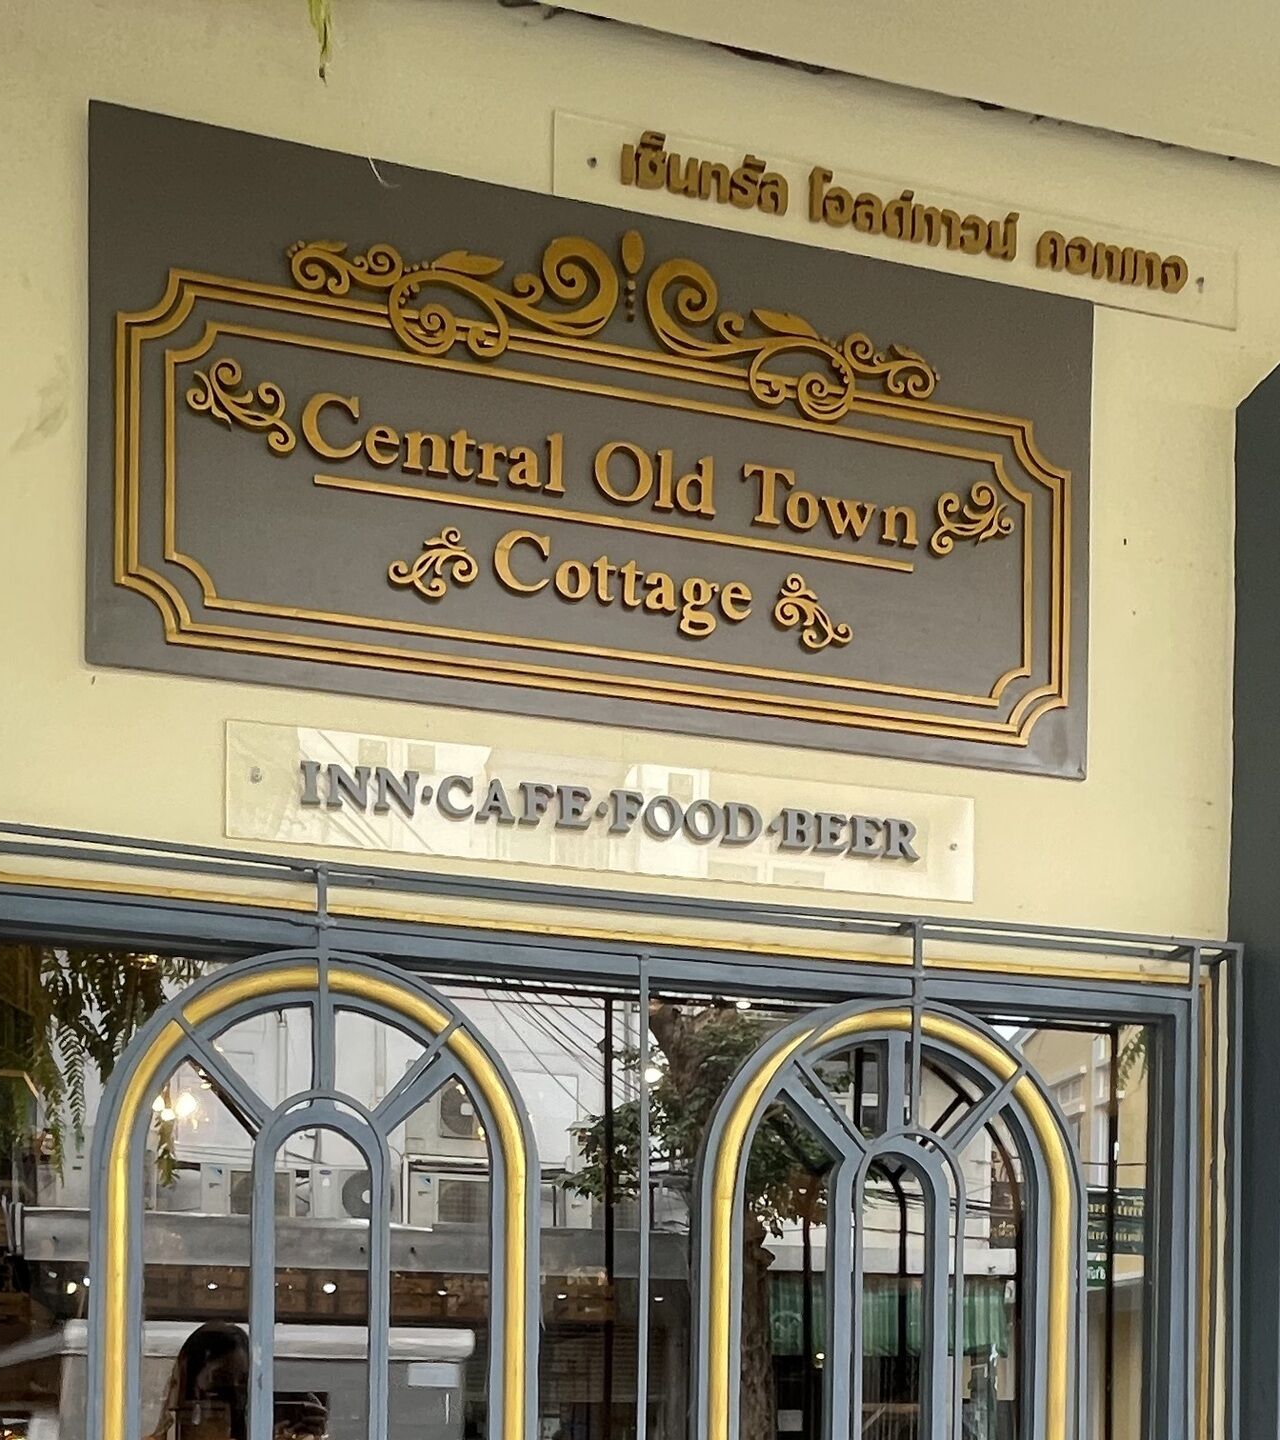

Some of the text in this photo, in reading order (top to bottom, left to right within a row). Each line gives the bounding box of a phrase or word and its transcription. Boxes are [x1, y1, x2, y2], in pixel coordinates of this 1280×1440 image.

[300, 391, 920, 549] Central Old Town
[493, 529, 754, 640] Cottage
